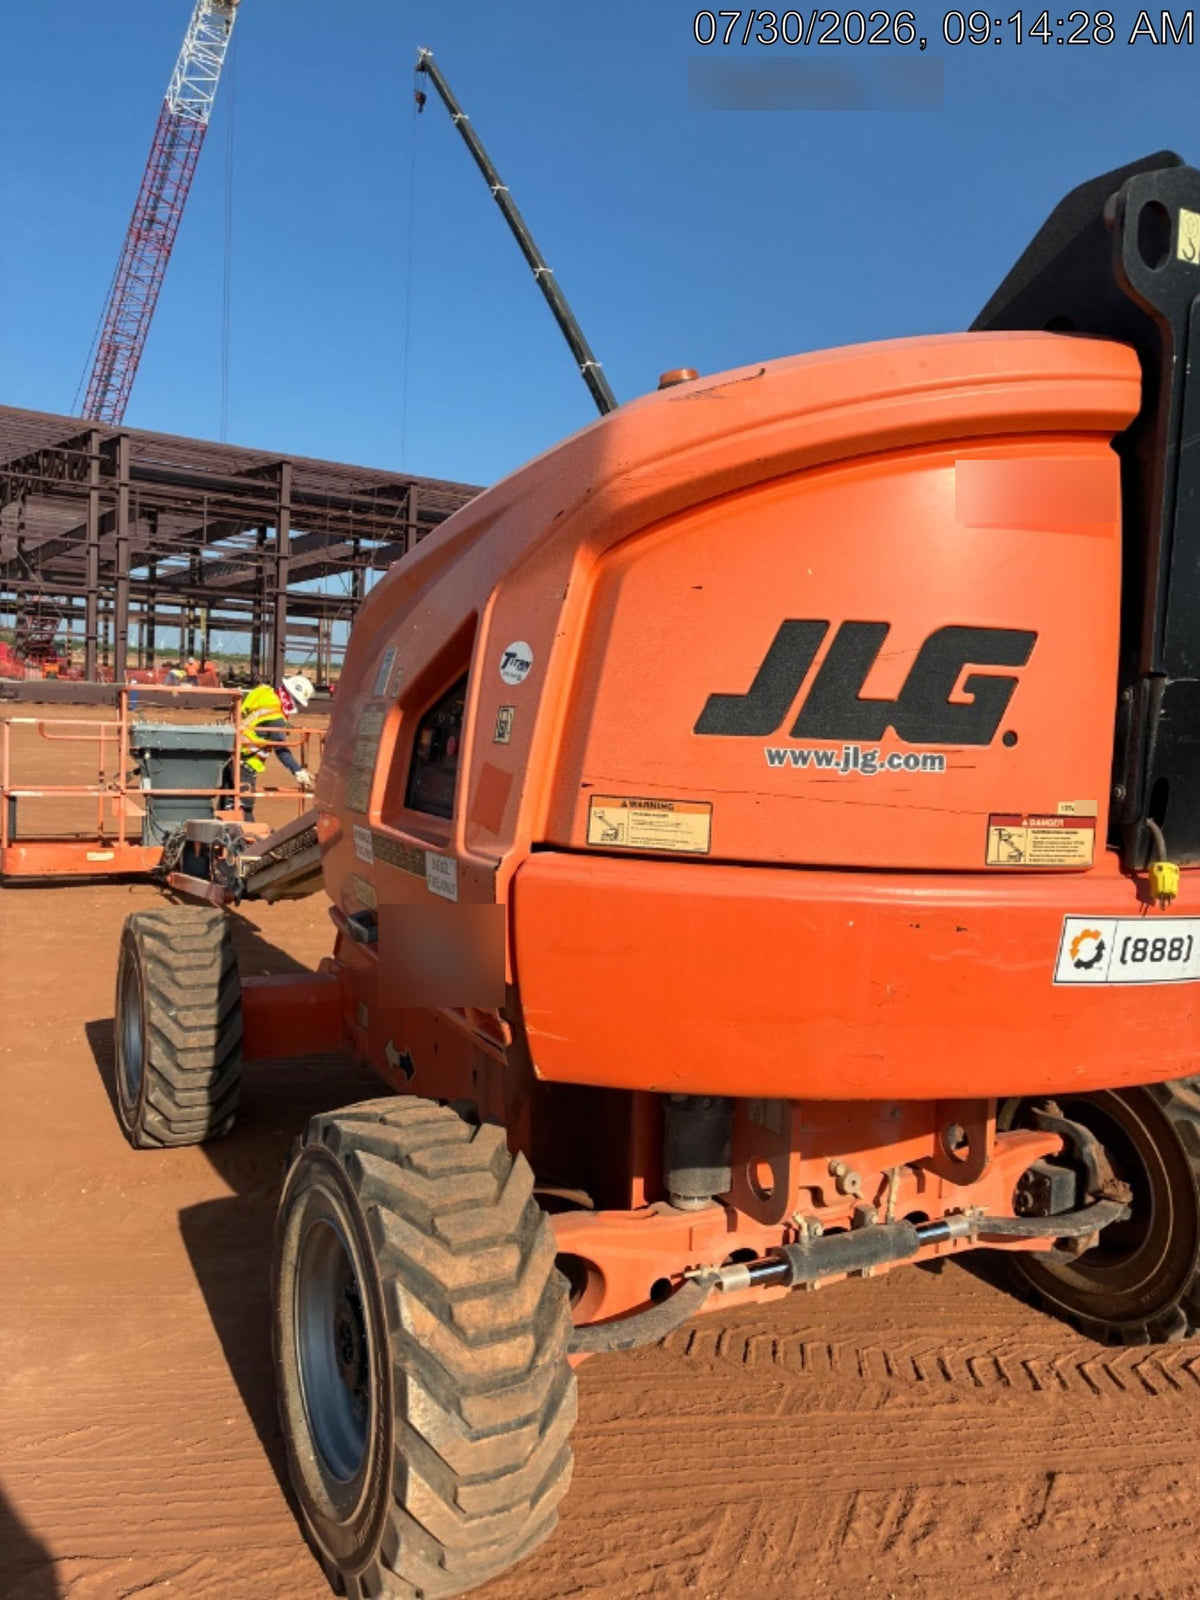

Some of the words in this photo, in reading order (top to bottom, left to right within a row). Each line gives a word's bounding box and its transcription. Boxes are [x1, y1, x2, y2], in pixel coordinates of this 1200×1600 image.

[764, 745, 947, 775] www.jlg.com
[628, 800, 675, 812] WARNING
[1119, 934, 1194, 966] (888)
